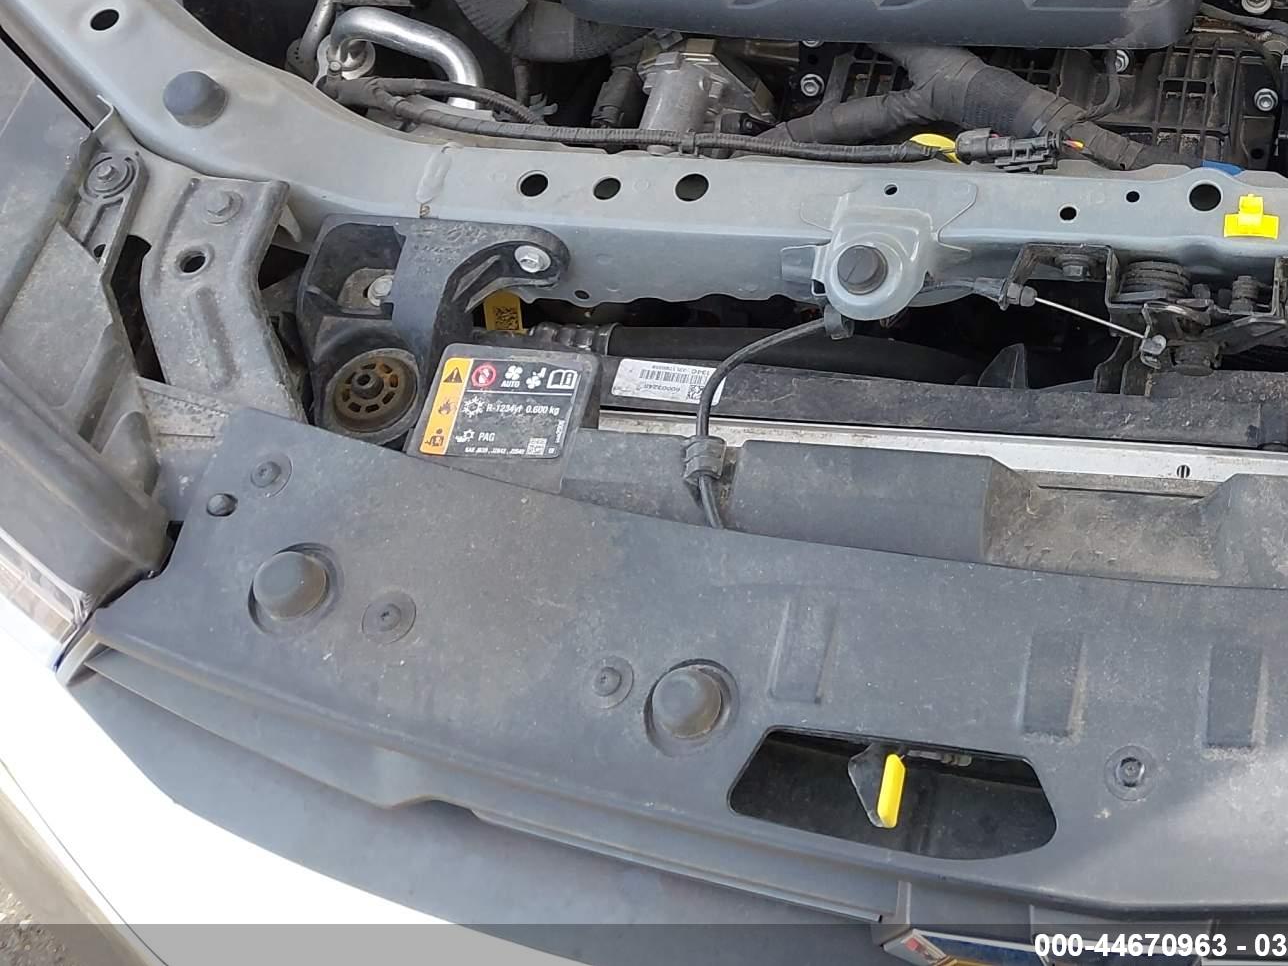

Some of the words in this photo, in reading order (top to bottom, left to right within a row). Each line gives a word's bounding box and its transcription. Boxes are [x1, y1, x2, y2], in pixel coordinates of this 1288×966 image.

[501, 380, 520, 388] AUTO
[486, 404, 522, 414] R-1234yf
[525, 406, 548, 414] 0.600
[549, 406, 560, 416] kg
[478, 432, 496, 442] PAG
